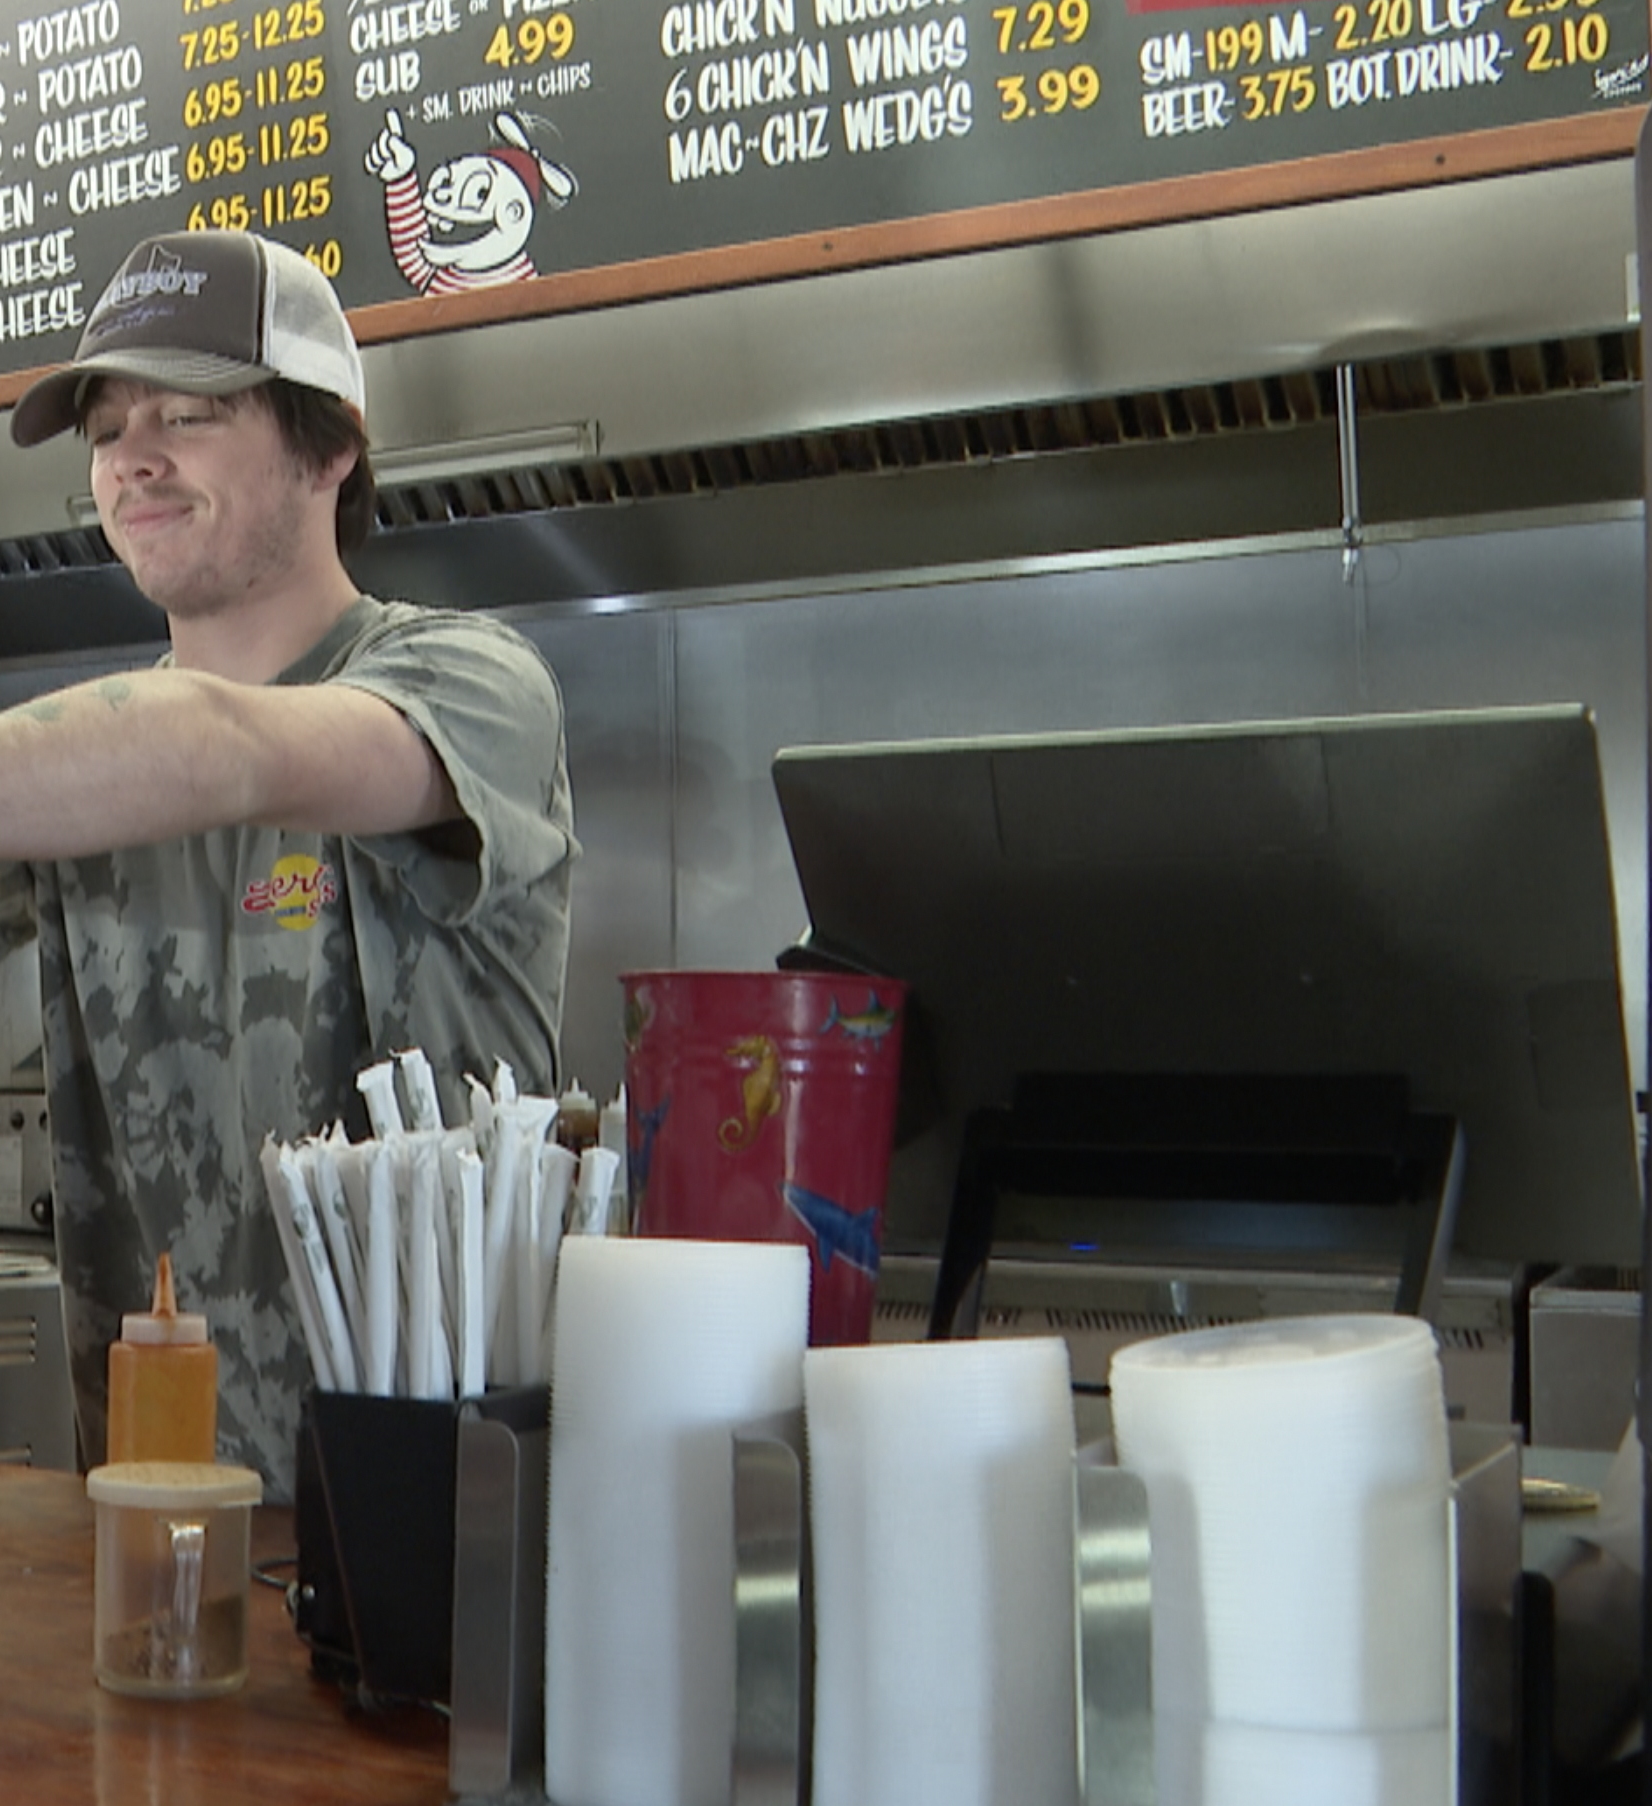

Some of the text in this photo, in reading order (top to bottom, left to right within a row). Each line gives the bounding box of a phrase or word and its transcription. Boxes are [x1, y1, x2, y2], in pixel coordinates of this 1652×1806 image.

[18, 0, 120, 65] POTATO
[350, 0, 461, 54] CHEESE
[484, 12, 575, 69] 4.99
[1333, 0, 1412, 50] 2.20
[38, 46, 143, 113] POTATO
[355, 50, 421, 102] SUB
[458, 78, 516, 116] DRINK
[537, 62, 592, 98] CHIPS
[664, 66, 691, 121] 6
[848, 16, 968, 87] WINGS
[991, 0, 1090, 54] 7.29
[1240, 66, 1316, 121] 3.75
[1525, 13, 1608, 72] 2.10
[35, 98, 149, 168] CHEESE
[843, 76, 973, 152] WEDG'S
[996, 64, 1100, 121] 3.99
[69, 146, 182, 215] CHEESE
